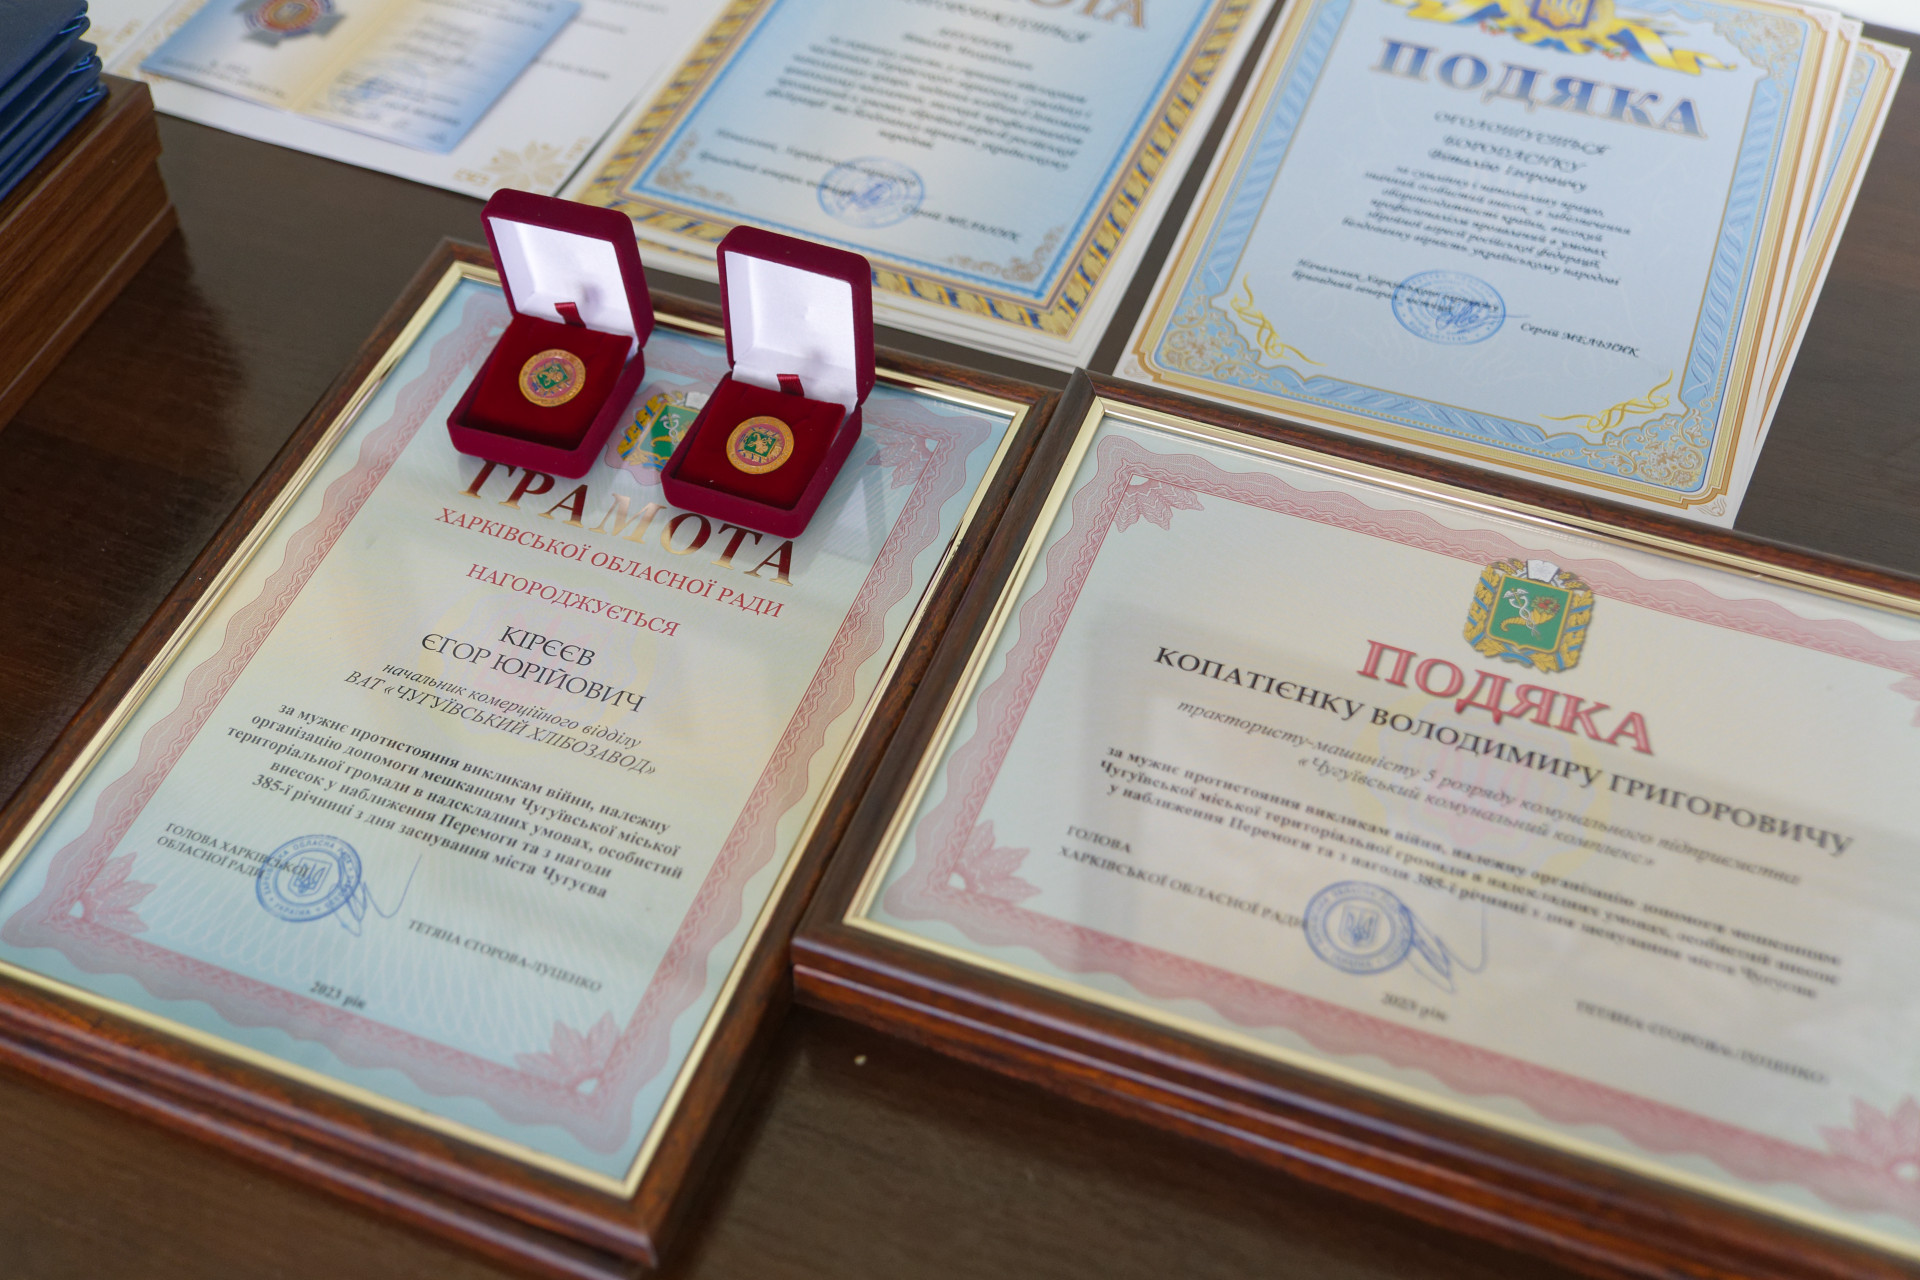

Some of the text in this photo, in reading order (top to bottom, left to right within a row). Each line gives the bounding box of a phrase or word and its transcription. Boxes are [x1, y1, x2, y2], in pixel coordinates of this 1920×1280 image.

[1370, 37, 1709, 140] ПОДЯКА
[435, 506, 784, 618] ХАРКІВСЬКОЇ ОБЛАСНОЇ РАДИ
[457, 459, 796, 587] ГРАМОТА
[466, 562, 679, 637] НАГОРОДЖУЄТЬСЯ
[498, 624, 596, 667] КІРЄЄВ
[343, 670, 394, 694] ВАТ
[526, 726, 656, 773] ХЛІБОЗАВОД»
[381, 663, 641, 748] начальник комерційного відділу
[420, 631, 644, 713] ЄГОР ЮРІЙОВИЧ
[1355, 639, 1655, 756] ПОДЯКА
[251, 715, 678, 857] організацію допомоги мешканцям Чугуївської міської
[278, 703, 666, 832] за мужнє протистояння викликам війни, належну
[1154, 645, 1852, 854] КОПАТІЄНКУ ВОЛОДИМИРУ ГРИГОРОВИЧУ
[164, 822, 217, 848] ГОЛОВА
[219, 841, 310, 877] ХАРКІВСЬКОЇ
[227, 727, 342, 771] територіальної
[343, 765, 410, 793] громади
[426, 791, 526, 830] надскладних
[533, 824, 593, 852] умовах,
[597, 845, 682, 879] особистий
[251, 773, 291, 796] 385-ї
[290, 789, 353, 816] річниці
[364, 814, 396, 830] дня
[399, 824, 490, 860] заснування
[494, 853, 536, 875] міста
[269, 761, 325, 786] внесок
[338, 784, 436, 822] наближення
[439, 813, 518, 847] Перемоги
[521, 841, 539, 855] та
[553, 852, 612, 878] нагоди
[1066, 825, 1131, 853] ГОЛОВА
[156, 835, 229, 866] ОБЛАСНОЇ
[226, 858, 266, 879] РАДИ
[1061, 846, 1309, 931] ХАРКІВСЬКОЇ ОБЛАСНОЇ РАДИ
[309, 980, 367, 1010] 2023 рік
